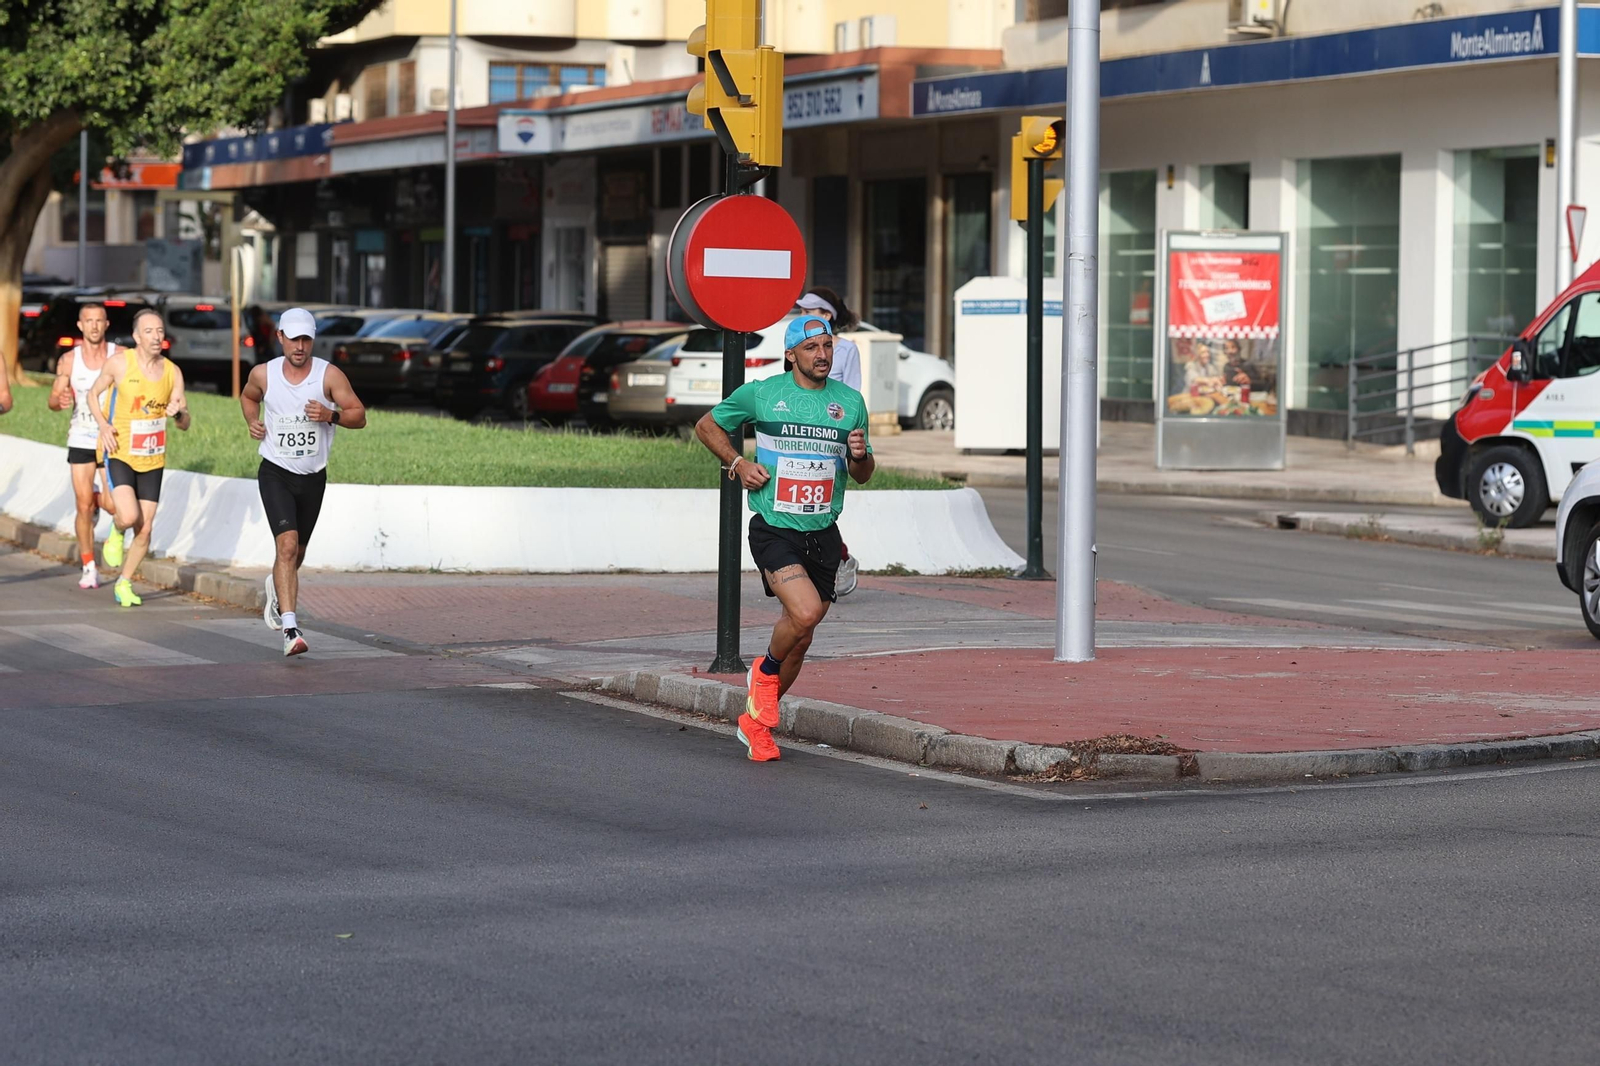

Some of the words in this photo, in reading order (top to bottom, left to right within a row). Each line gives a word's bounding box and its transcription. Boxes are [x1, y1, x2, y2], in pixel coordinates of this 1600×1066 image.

[1451, 26, 1531, 58] MonteAlminara
[277, 431, 316, 447] 7835
[781, 424, 838, 440] ATLETISMO
[142, 436, 158, 449] 40
[773, 439, 843, 454] TORREMOLINOS
[788, 484, 825, 504] 138
